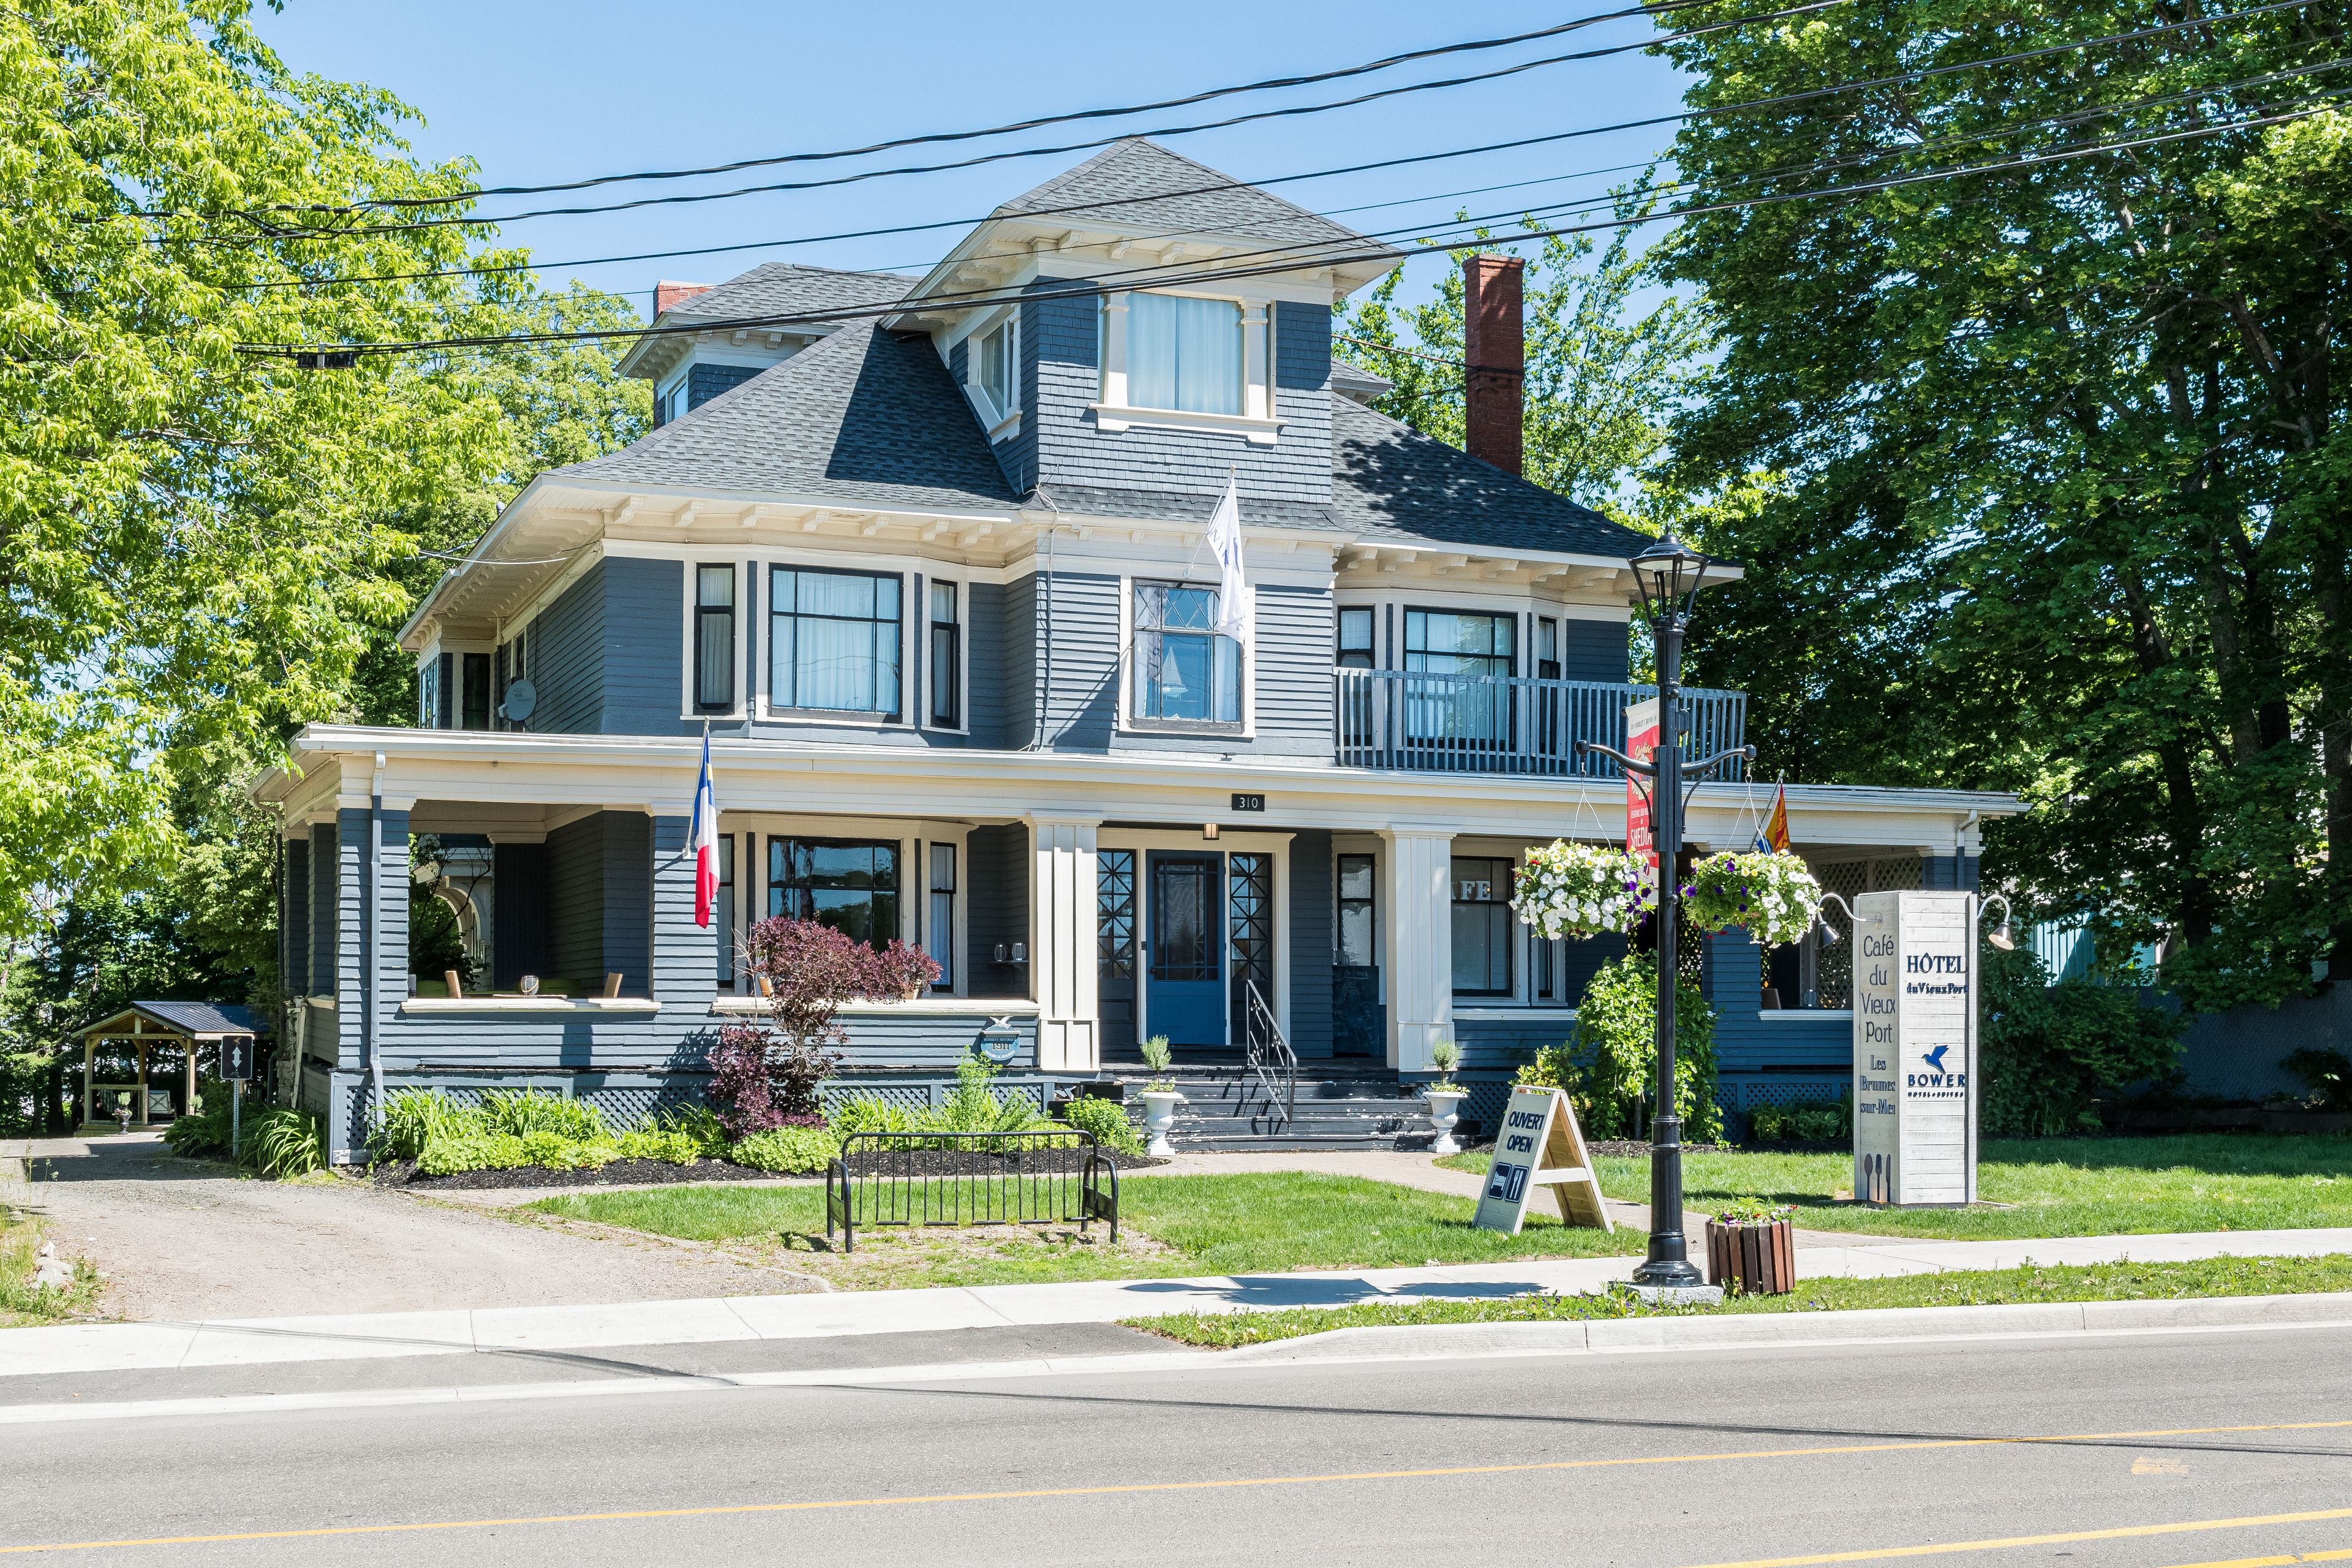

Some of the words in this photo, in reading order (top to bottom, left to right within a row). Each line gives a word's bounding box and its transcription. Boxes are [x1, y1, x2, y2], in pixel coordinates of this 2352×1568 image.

[1239, 797, 1258, 809] 310
[1630, 826, 1653, 848] SHEDIA
[1863, 934, 1894, 957] Café
[1906, 952, 1969, 974] HÔTEL
[1869, 964, 1887, 986] du
[1860, 992, 1896, 1014] Vieux
[1866, 1021, 1893, 1043] Port
[992, 1042, 1010, 1051] 1911
[1869, 1054, 1887, 1071] Les
[1859, 1075, 1896, 1091] Brumes
[1907, 1074, 1967, 1088] BOWER
[1509, 1111, 1545, 1130] OUVERT
[1507, 1134, 1534, 1153] OPEN
